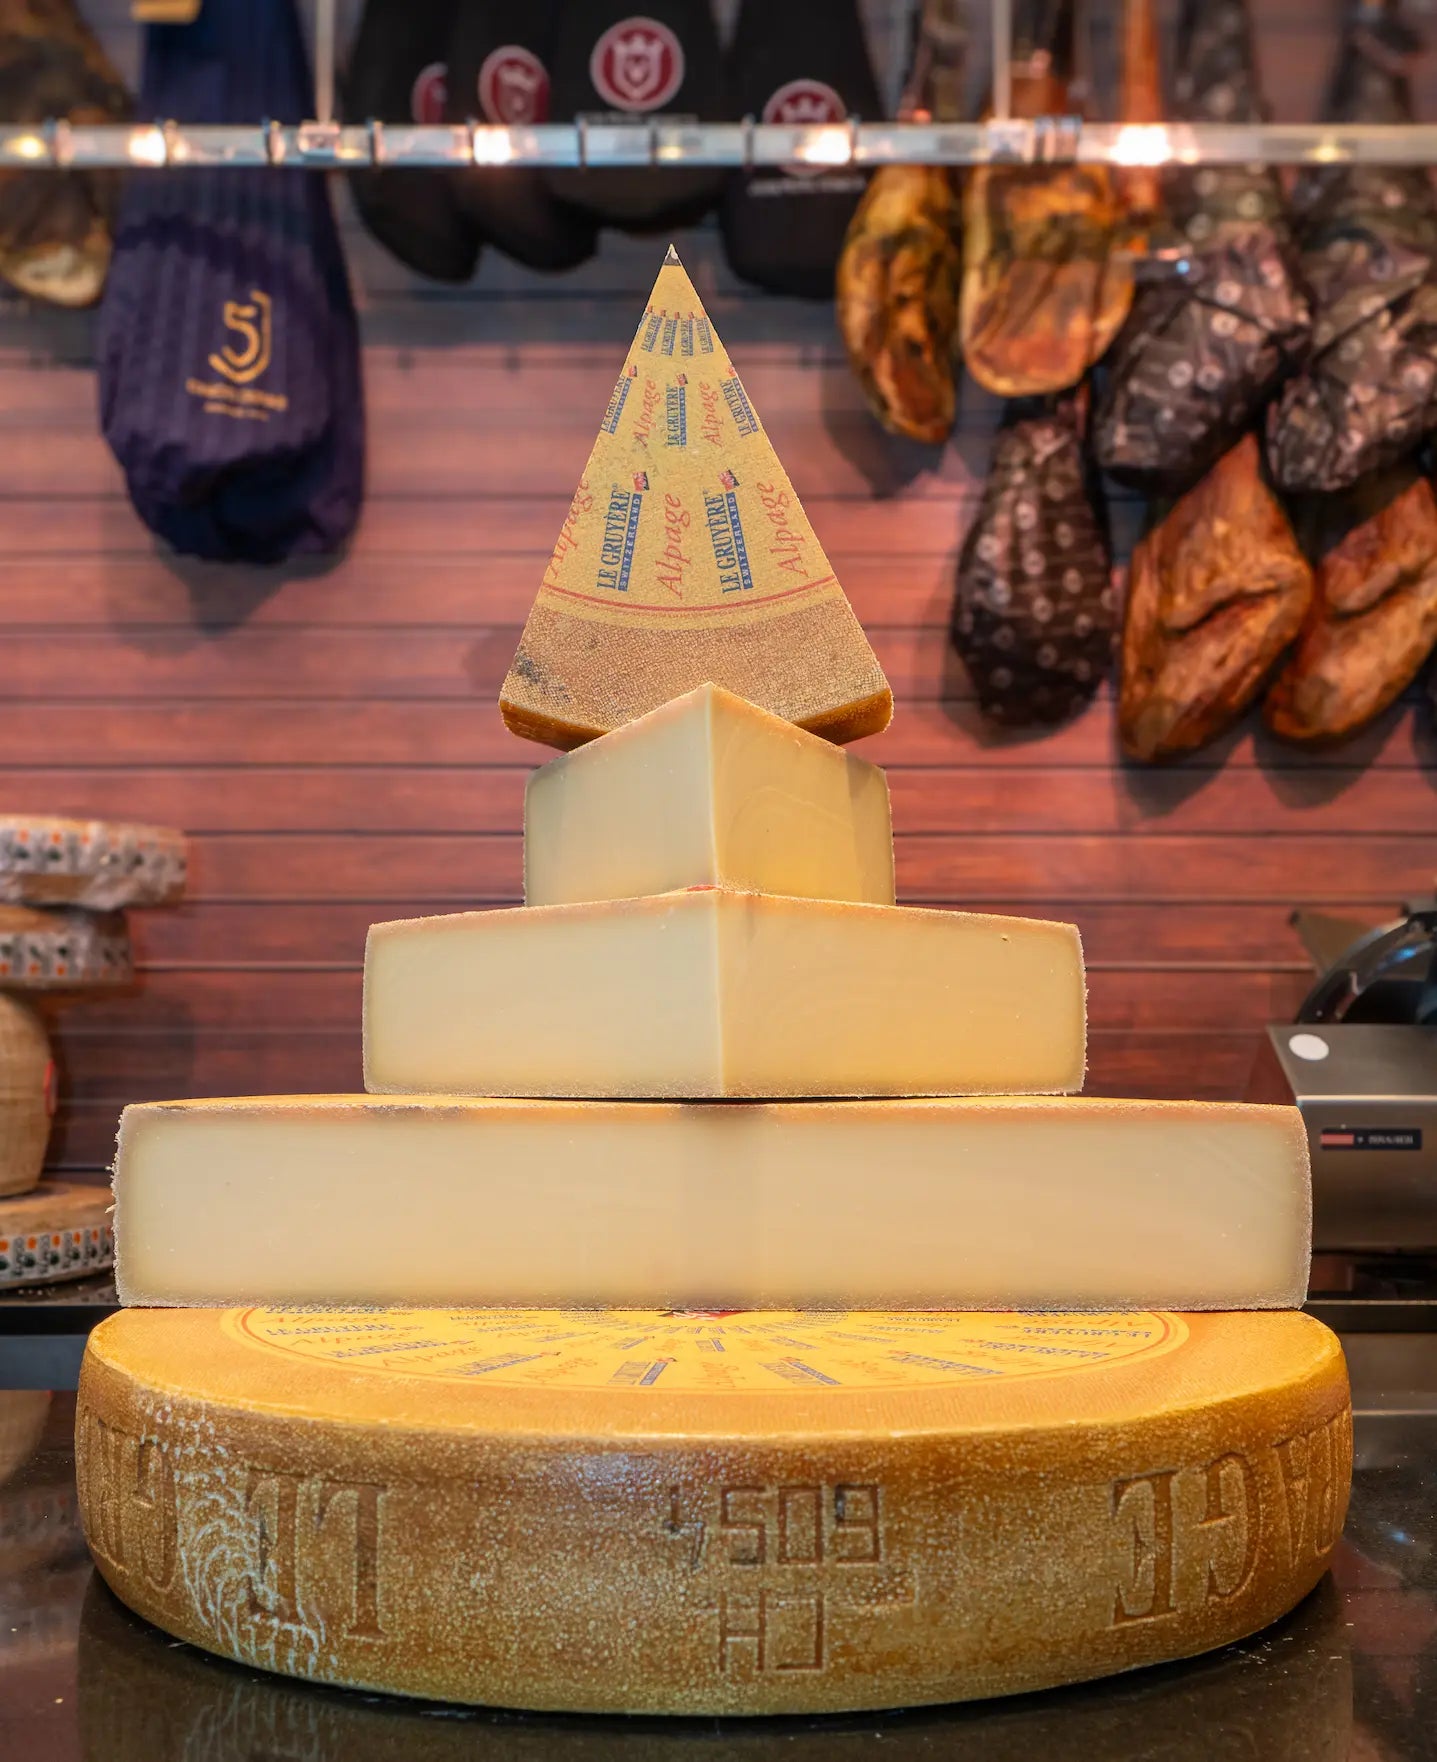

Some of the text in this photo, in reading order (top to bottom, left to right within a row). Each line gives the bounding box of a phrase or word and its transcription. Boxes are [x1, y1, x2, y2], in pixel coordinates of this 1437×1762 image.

[633, 378, 660, 448] Alpage
[667, 433, 680, 446] LE
[699, 381, 724, 448] Alpage
[738, 423, 752, 438] LE
[619, 495, 641, 591] SWITZERLAND
[655, 493, 691, 601] Alpage
[726, 493, 753, 588] SWITZERLAND
[757, 480, 810, 577] Alpage
[596, 569, 618, 590] LE
[720, 572, 742, 594] LE
